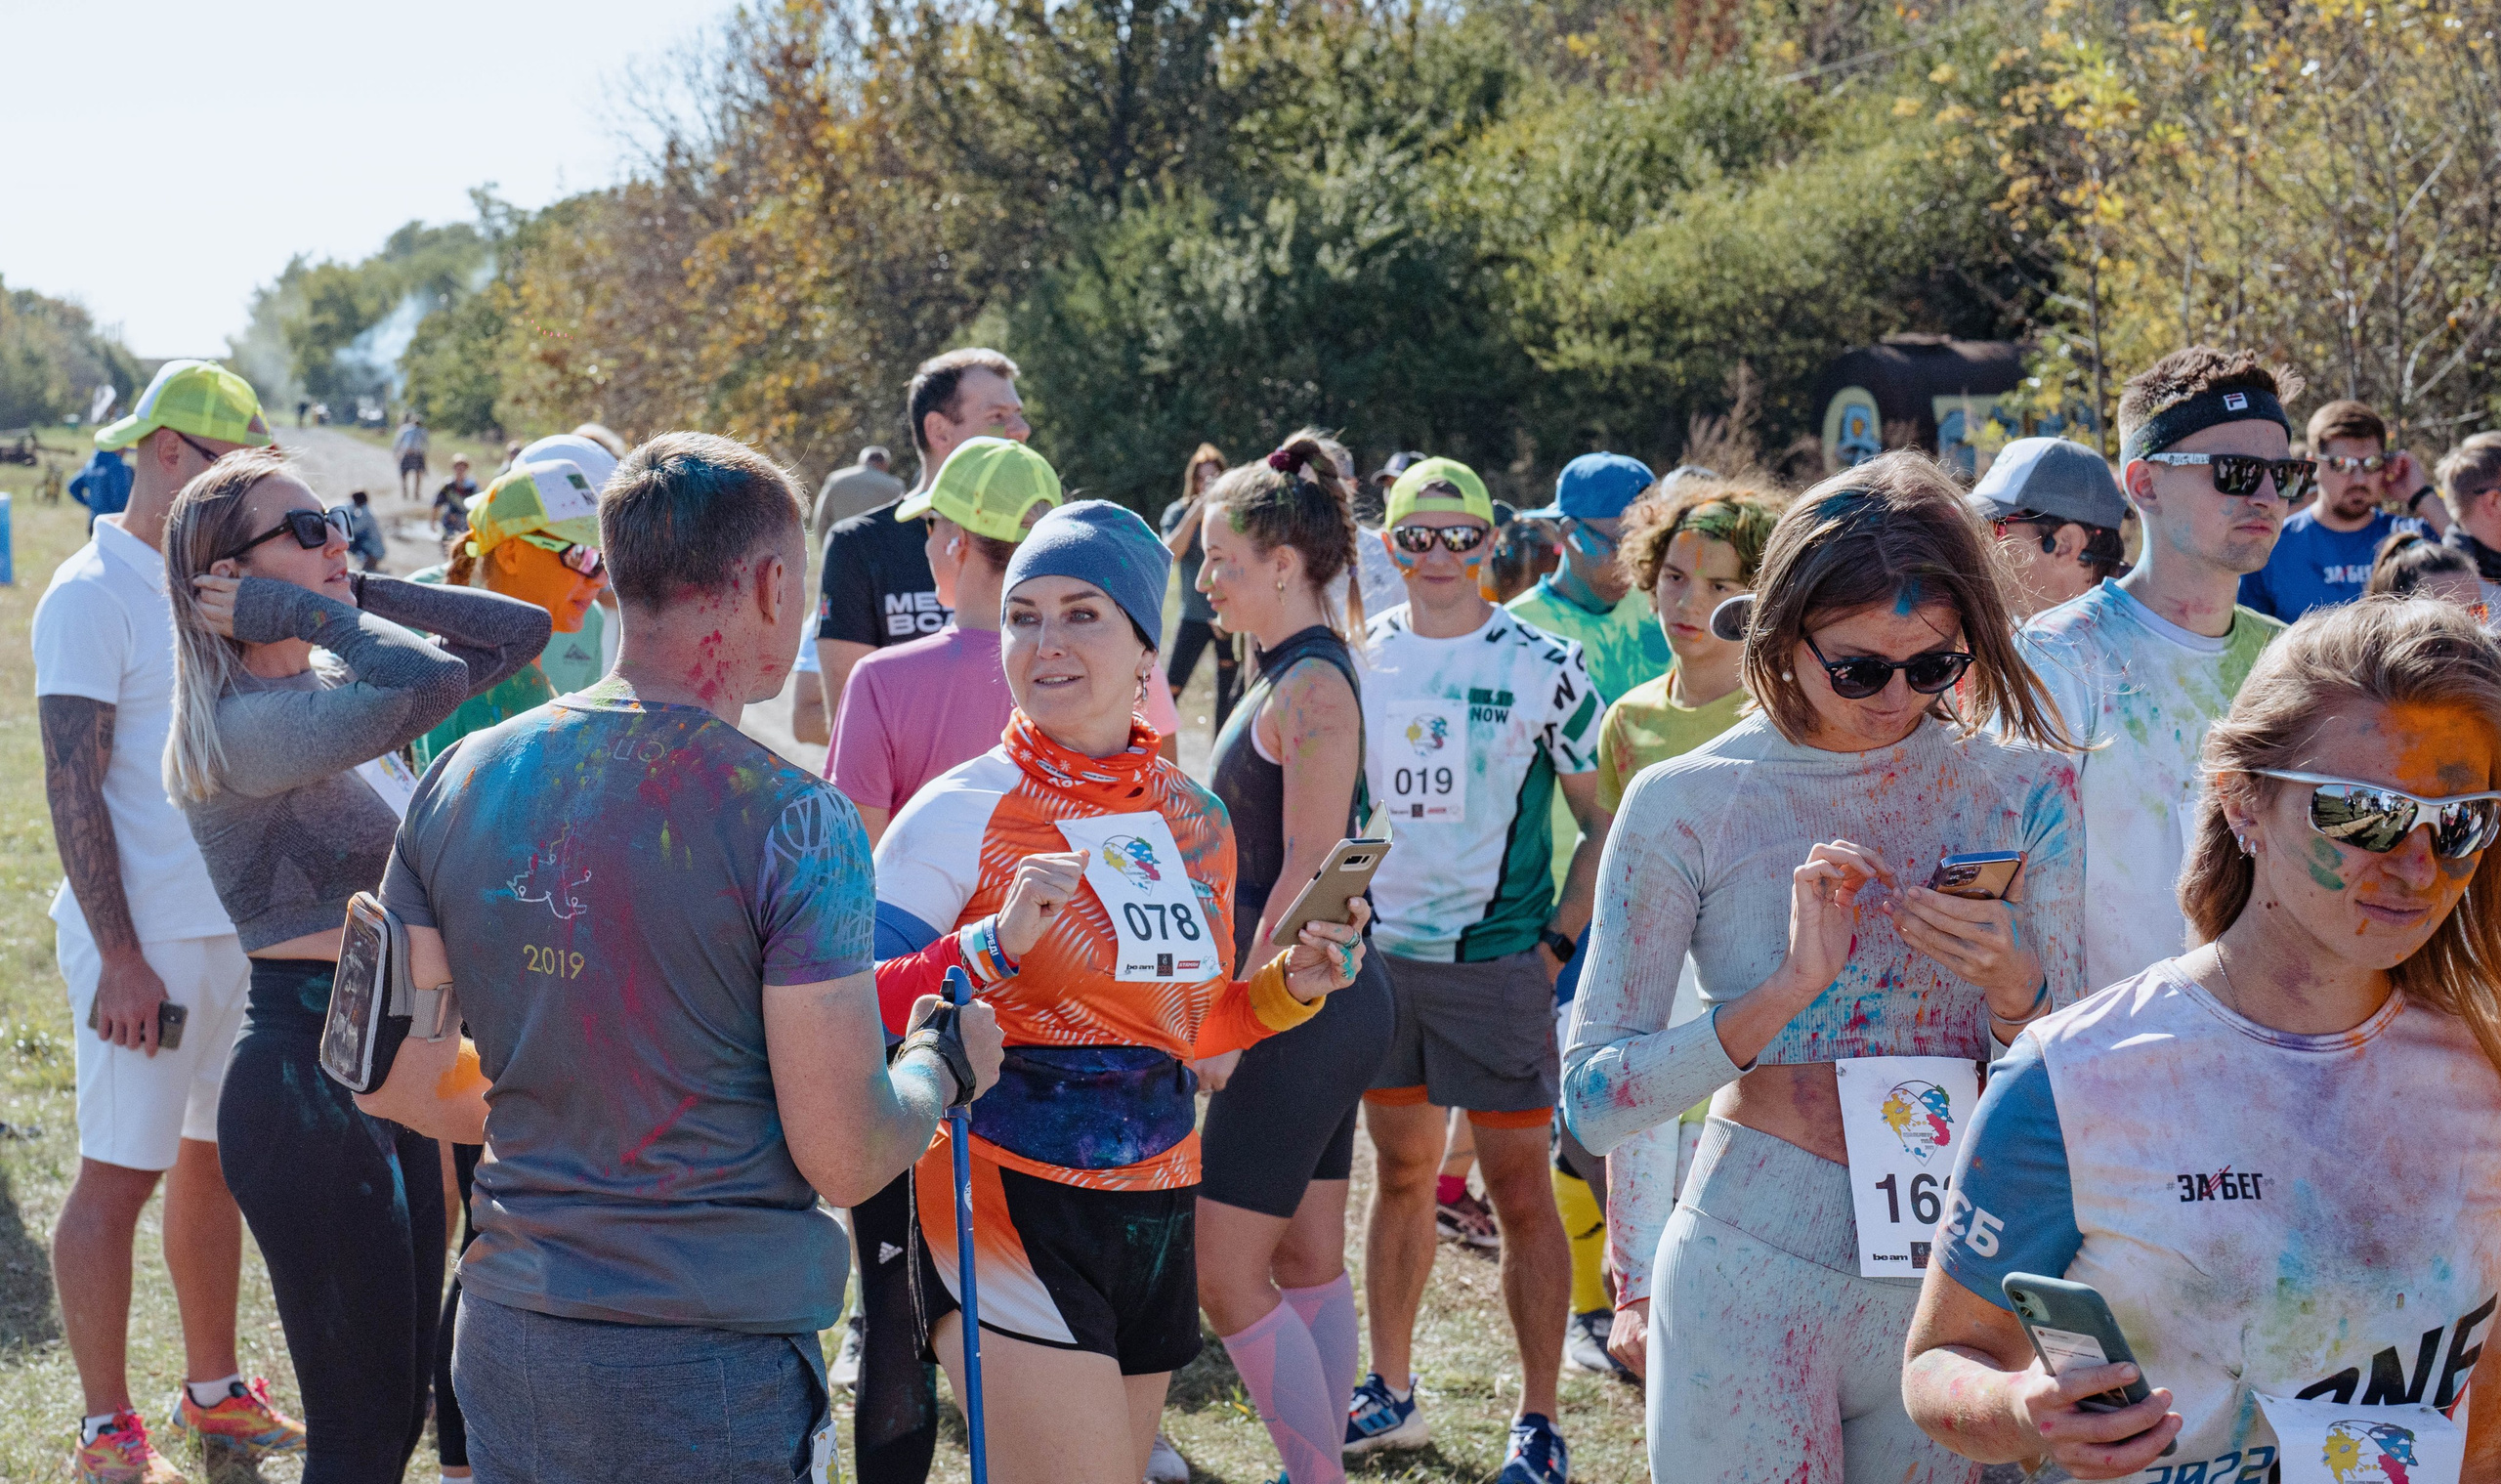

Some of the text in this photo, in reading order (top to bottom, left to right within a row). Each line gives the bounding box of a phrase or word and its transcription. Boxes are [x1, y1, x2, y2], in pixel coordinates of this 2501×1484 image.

[1469, 706, 1509, 724] NOW
[1395, 768, 1454, 795] 019
[1123, 902, 1201, 942] 078
[523, 944, 585, 980] 2019
[1875, 1172, 1952, 1225] 16
